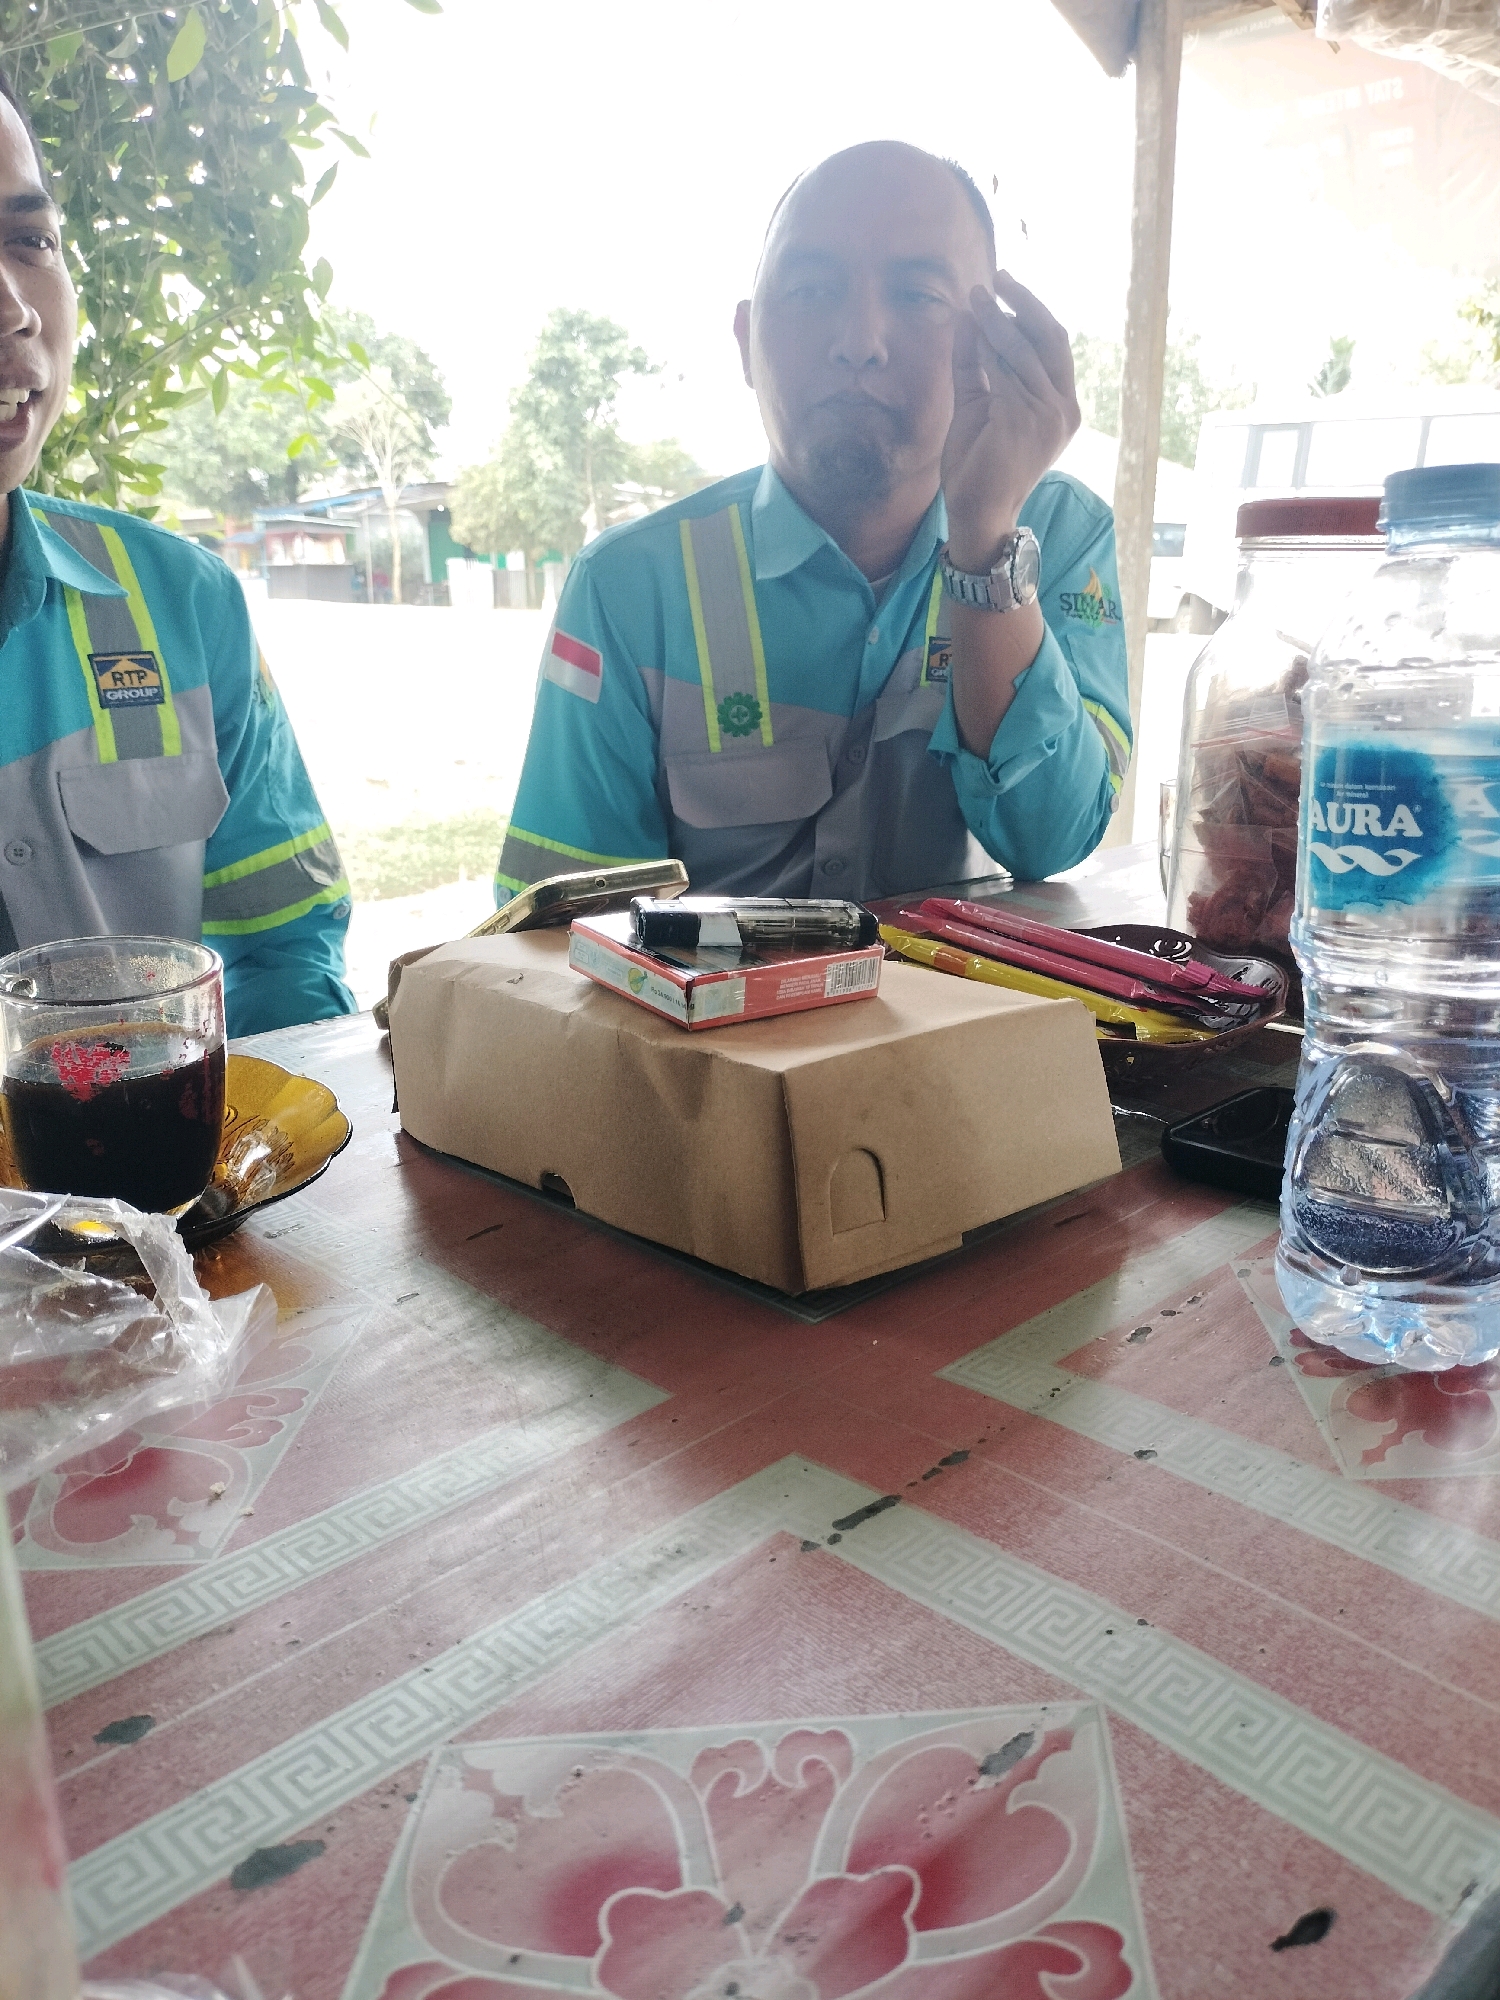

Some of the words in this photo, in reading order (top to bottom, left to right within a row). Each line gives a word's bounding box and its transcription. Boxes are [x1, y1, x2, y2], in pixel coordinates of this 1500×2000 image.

[111, 670, 148, 686] RTP
[106, 688, 158, 700] GROUP
[1311, 798, 1424, 837] AURA
